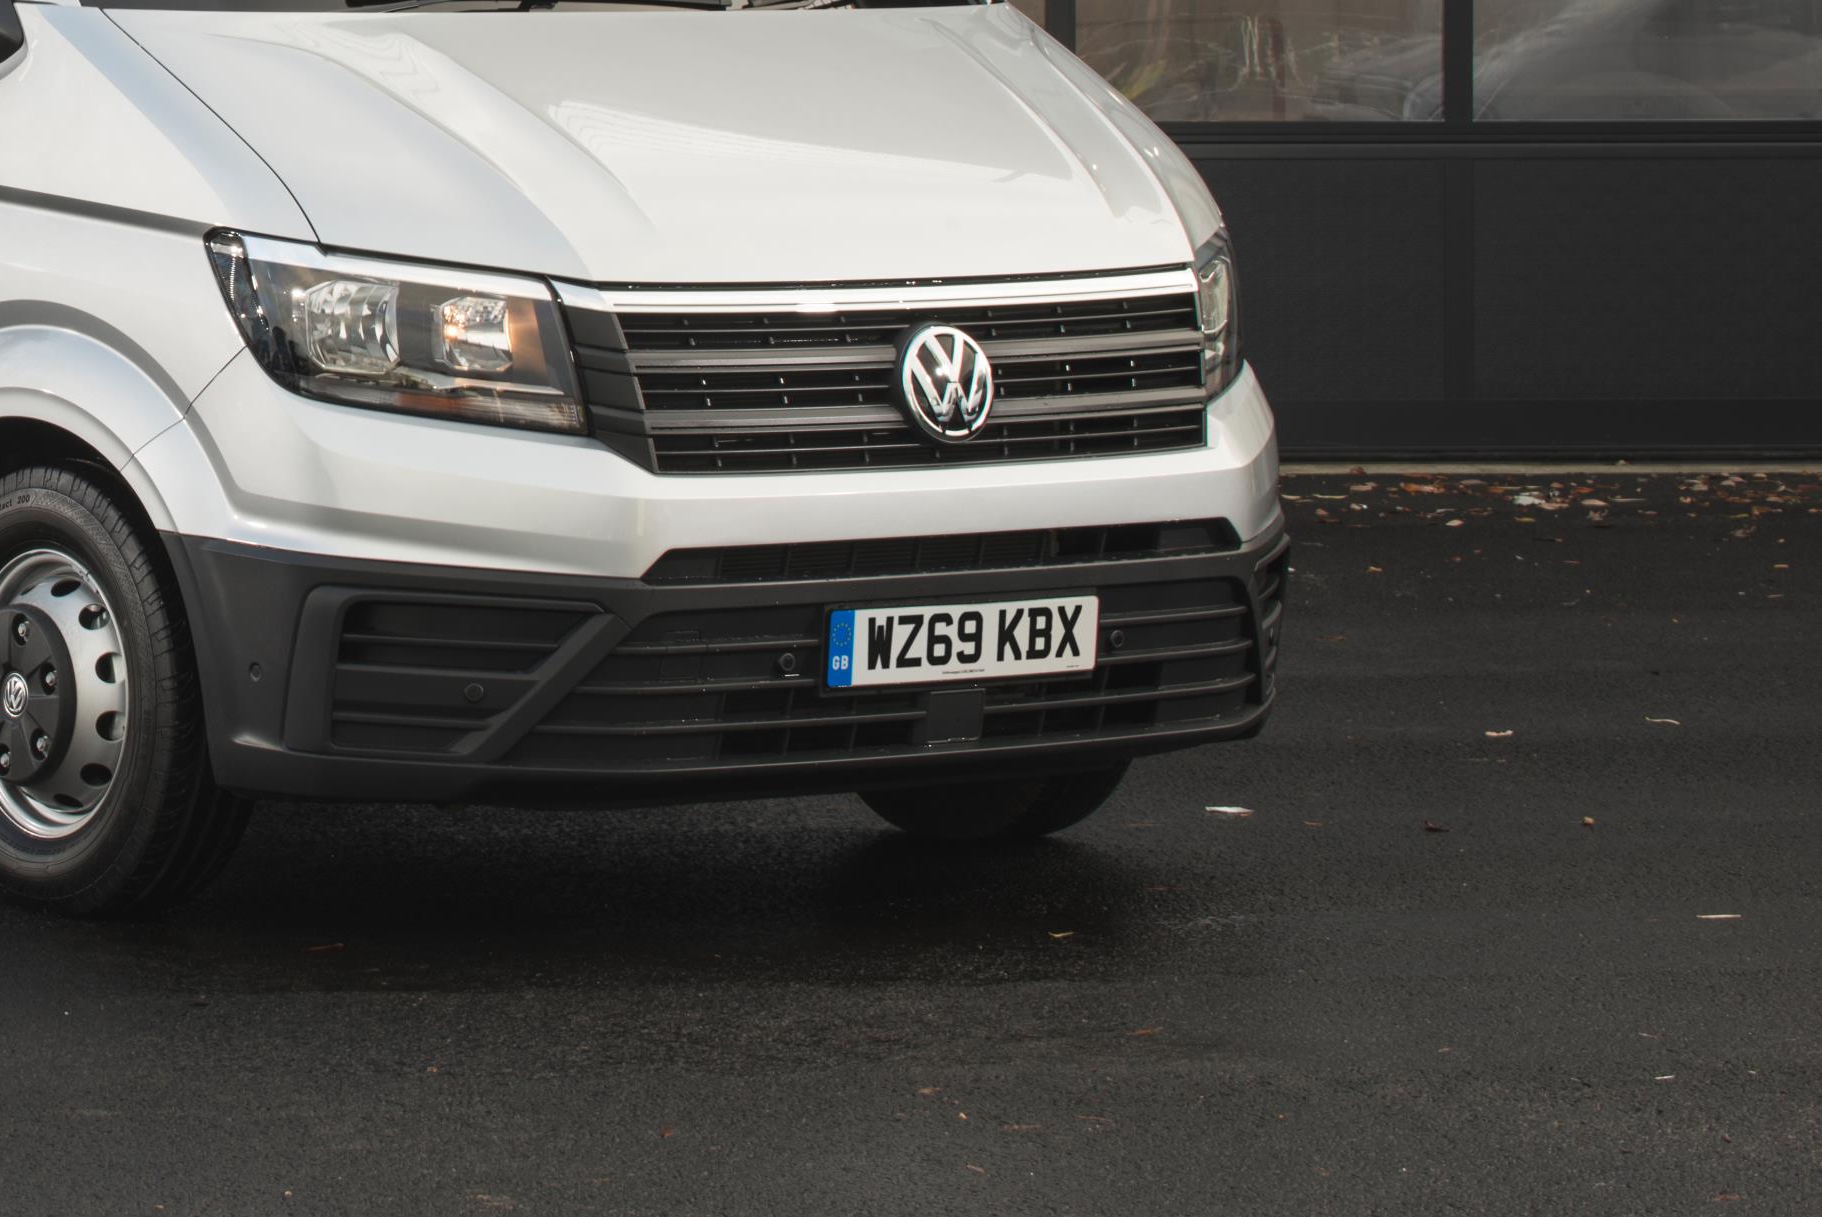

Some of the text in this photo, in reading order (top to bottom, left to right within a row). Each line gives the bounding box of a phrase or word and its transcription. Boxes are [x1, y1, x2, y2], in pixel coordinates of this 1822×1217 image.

[17, 494, 31, 505] 200
[867, 605, 1083, 671] WZ69 KBX
[832, 655, 849, 670] GB
